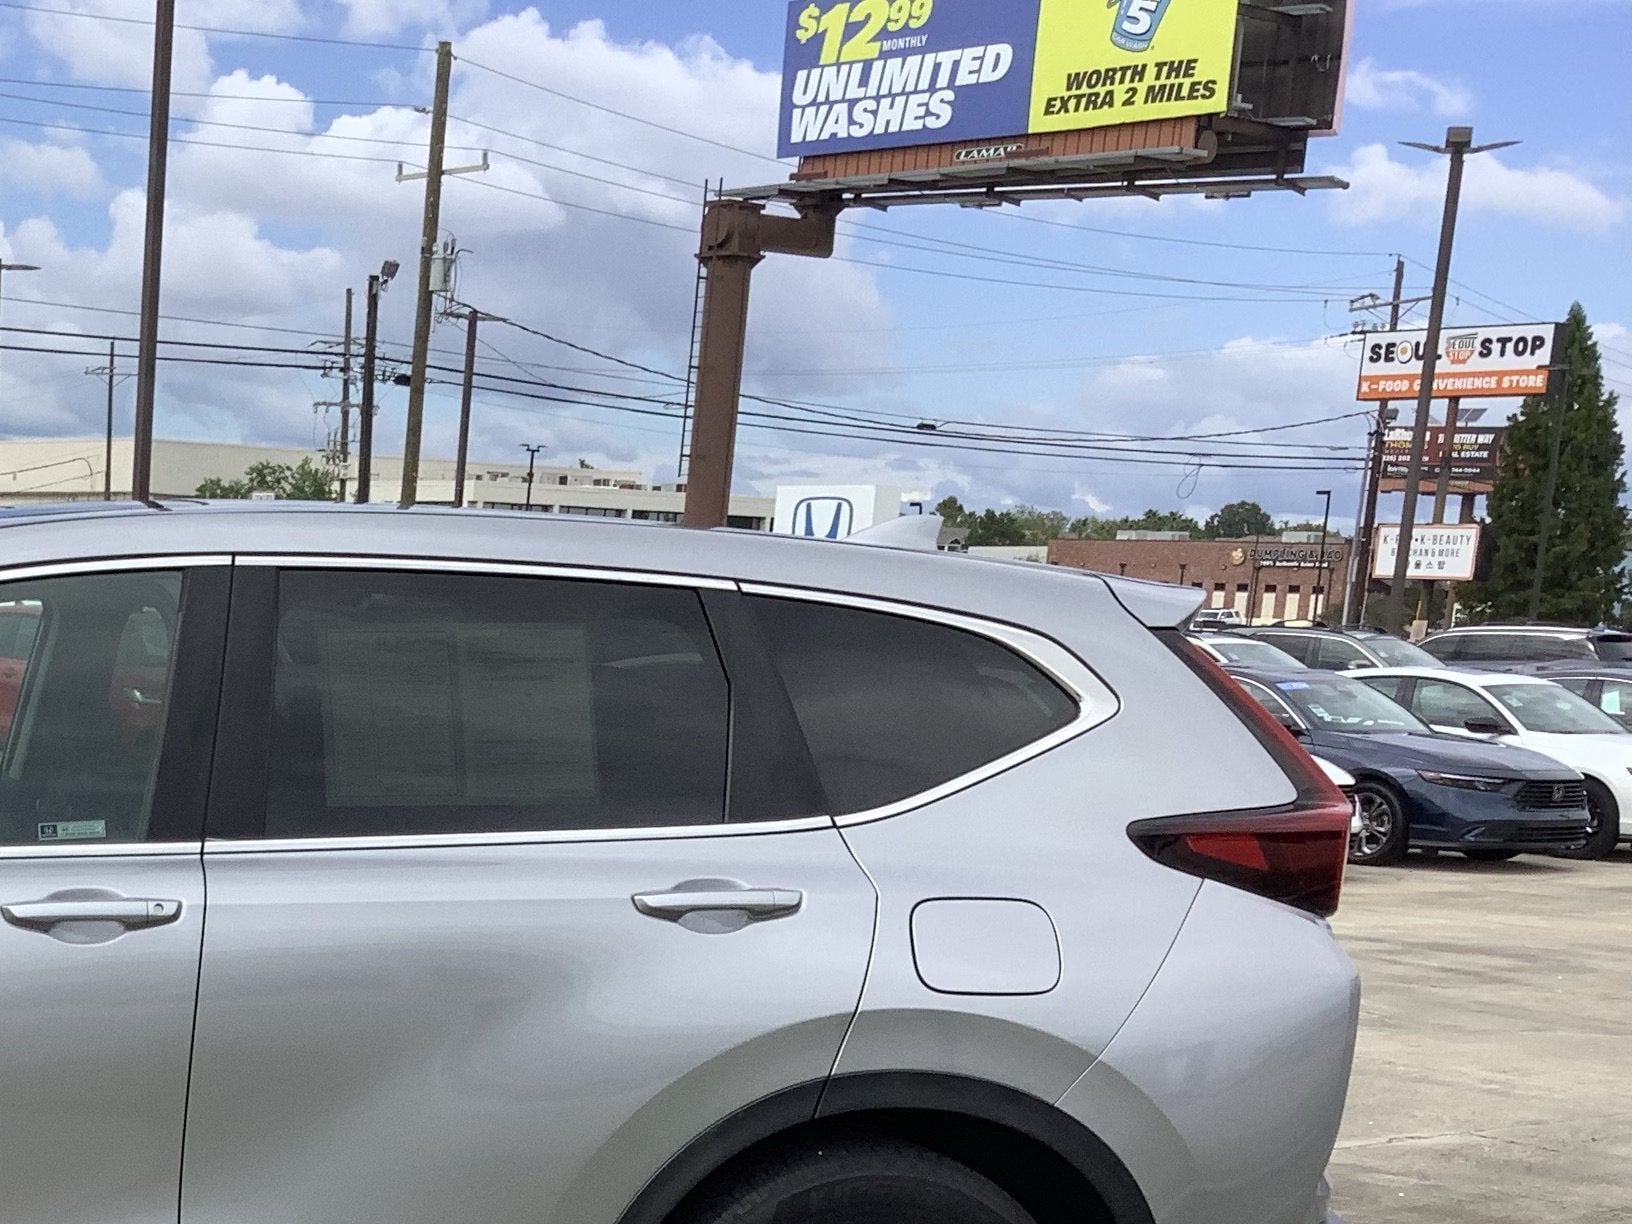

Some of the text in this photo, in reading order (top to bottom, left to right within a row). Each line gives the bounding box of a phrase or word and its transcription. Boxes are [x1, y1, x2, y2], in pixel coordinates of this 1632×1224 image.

[882, 34, 928, 51] MONTHLY
[792, 43, 1013, 106] UNLIMITED
[1065, 58, 1199, 92] WORTH THE
[1043, 79, 1218, 116] EXTRA 2 MILES
[790, 89, 955, 144] WASHES
[1369, 335, 1546, 365] SEOU STOP
[1361, 375, 1544, 393] K-FOOD CNVENIENCE STORE
